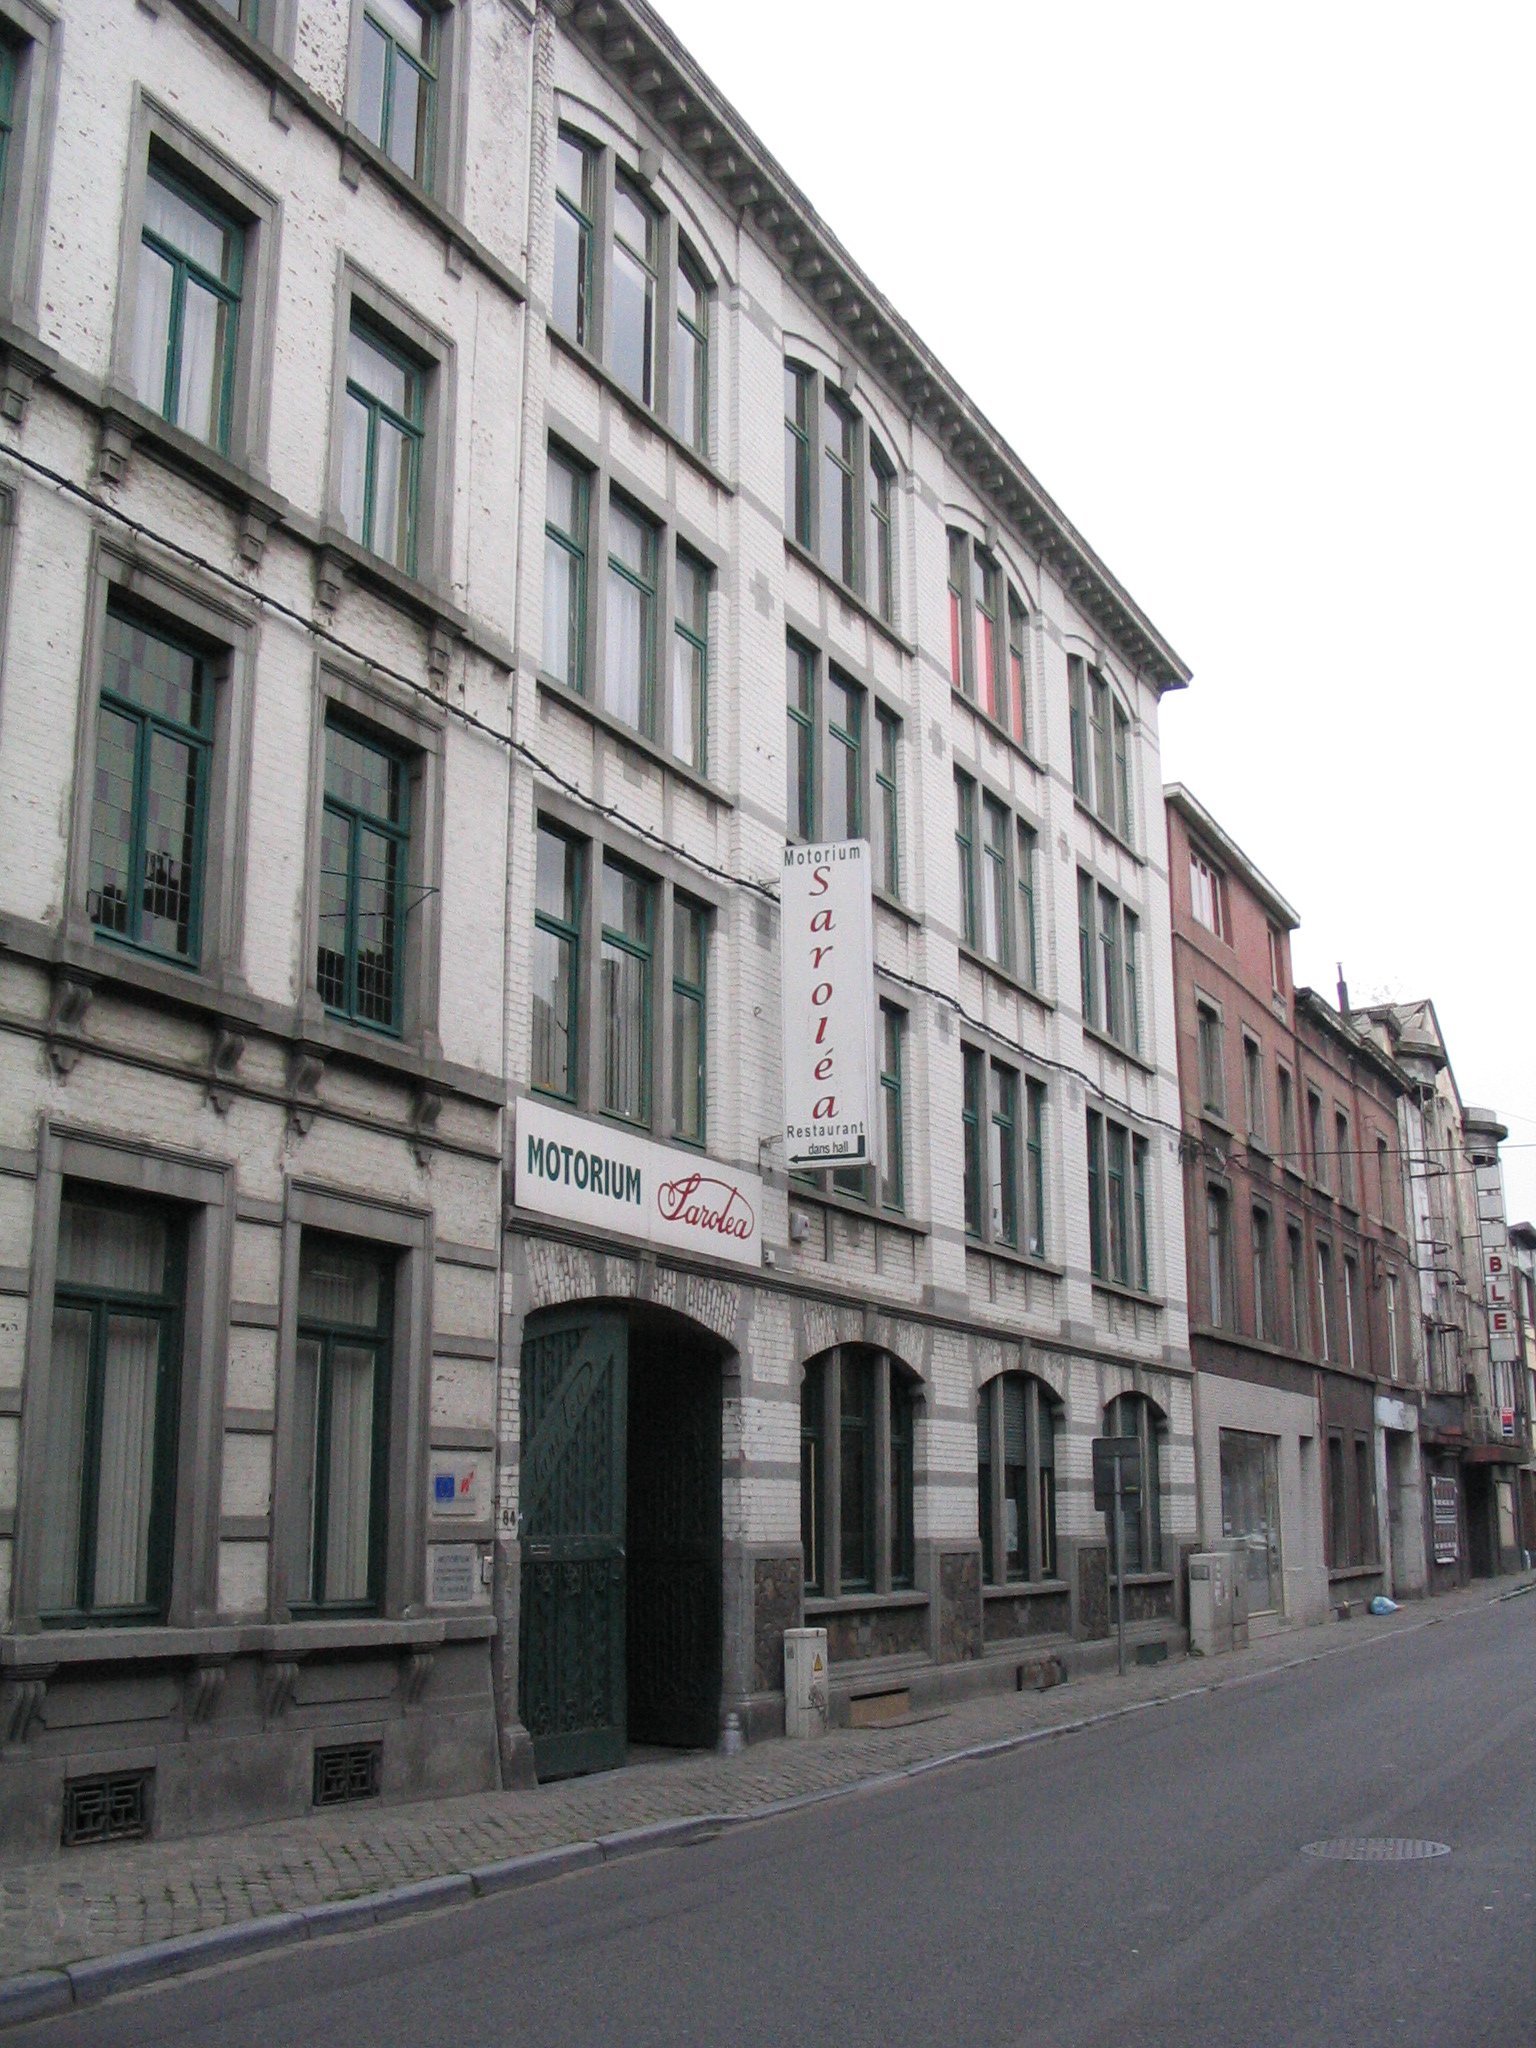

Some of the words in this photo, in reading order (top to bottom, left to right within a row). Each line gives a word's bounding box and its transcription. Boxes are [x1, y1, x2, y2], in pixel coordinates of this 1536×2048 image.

[784, 843, 861, 867] Motorium
[808, 865, 840, 1120] Saroléa
[787, 1121, 865, 1139] Restaurant
[808, 1141, 831, 1156] dans
[832, 1141, 849, 1155] hall
[527, 1134, 641, 1205] MOTORIUM
[502, 1509, 516, 1527] 84
